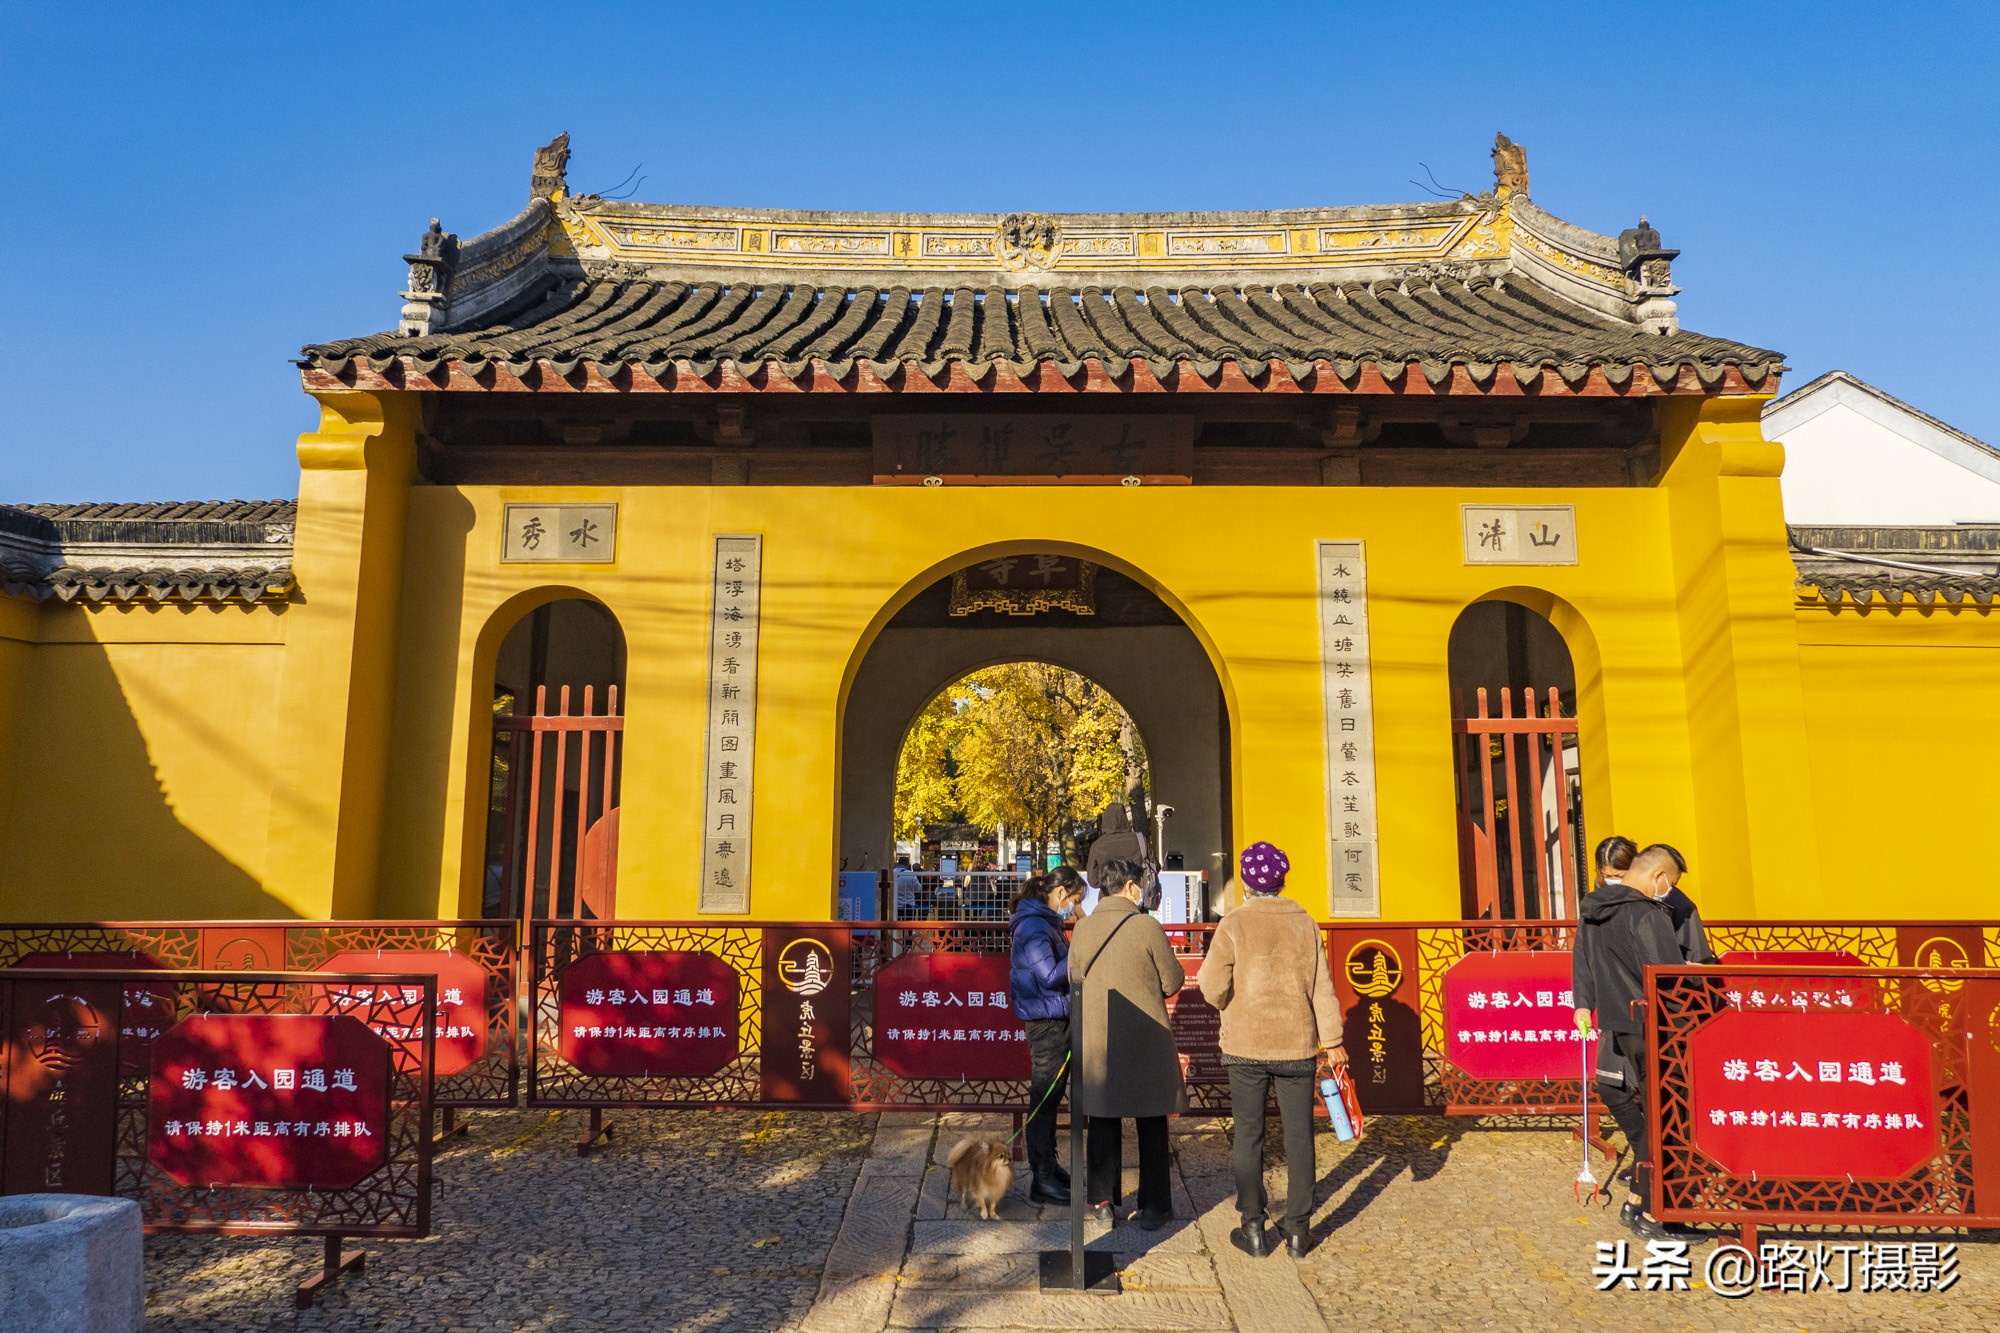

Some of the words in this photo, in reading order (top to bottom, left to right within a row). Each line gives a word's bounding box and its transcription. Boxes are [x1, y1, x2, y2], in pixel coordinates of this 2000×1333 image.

[585, 988, 715, 1006] 游客入园通道
[898, 990, 1009, 1008] 游客入园通
[1467, 990, 1575, 1009] 游客入园通
[573, 1025, 726, 1039] 请保持1米距离有序排队
[887, 1028, 1026, 1042] 请保持1米距离有序排
[1457, 1029, 1599, 1043] 请保持1米距离有序排
[181, 1067, 358, 1092] 游客入园通道
[1722, 1058, 1907, 1086] 游客入园通道
[1708, 1109, 1924, 1129] 请保持1米距离有序排队
[164, 1120, 372, 1138] 请保持1米距离有序排队
